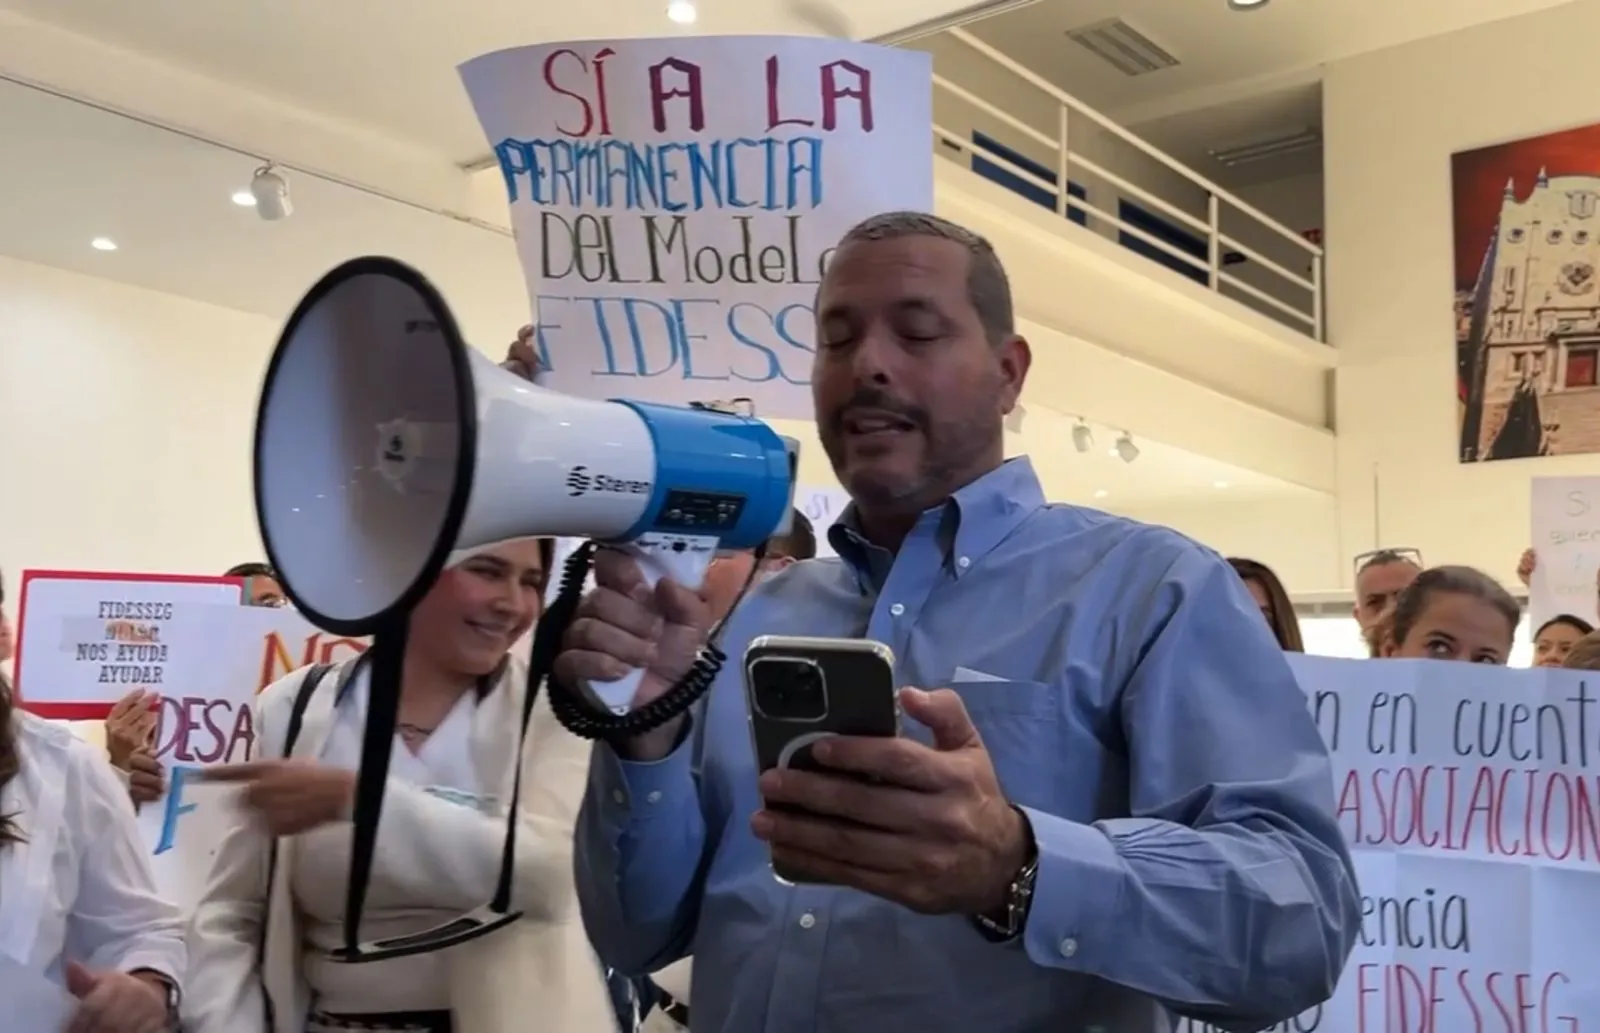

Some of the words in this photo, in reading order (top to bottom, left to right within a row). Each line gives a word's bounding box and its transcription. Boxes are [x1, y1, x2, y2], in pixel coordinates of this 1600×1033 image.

[543, 47, 616, 138] SÍ
[648, 56, 705, 132] A
[764, 54, 875, 133] LA
[494, 136, 824, 212] PERMANENCIA
[97, 600, 173, 620] FIDESSEG
[76, 643, 108, 661] NOS
[115, 644, 168, 662] AYUDA
[98, 665, 163, 684] AYUDAR
[1367, 691, 1417, 755] en
[1453, 681, 1600, 768] cuent
